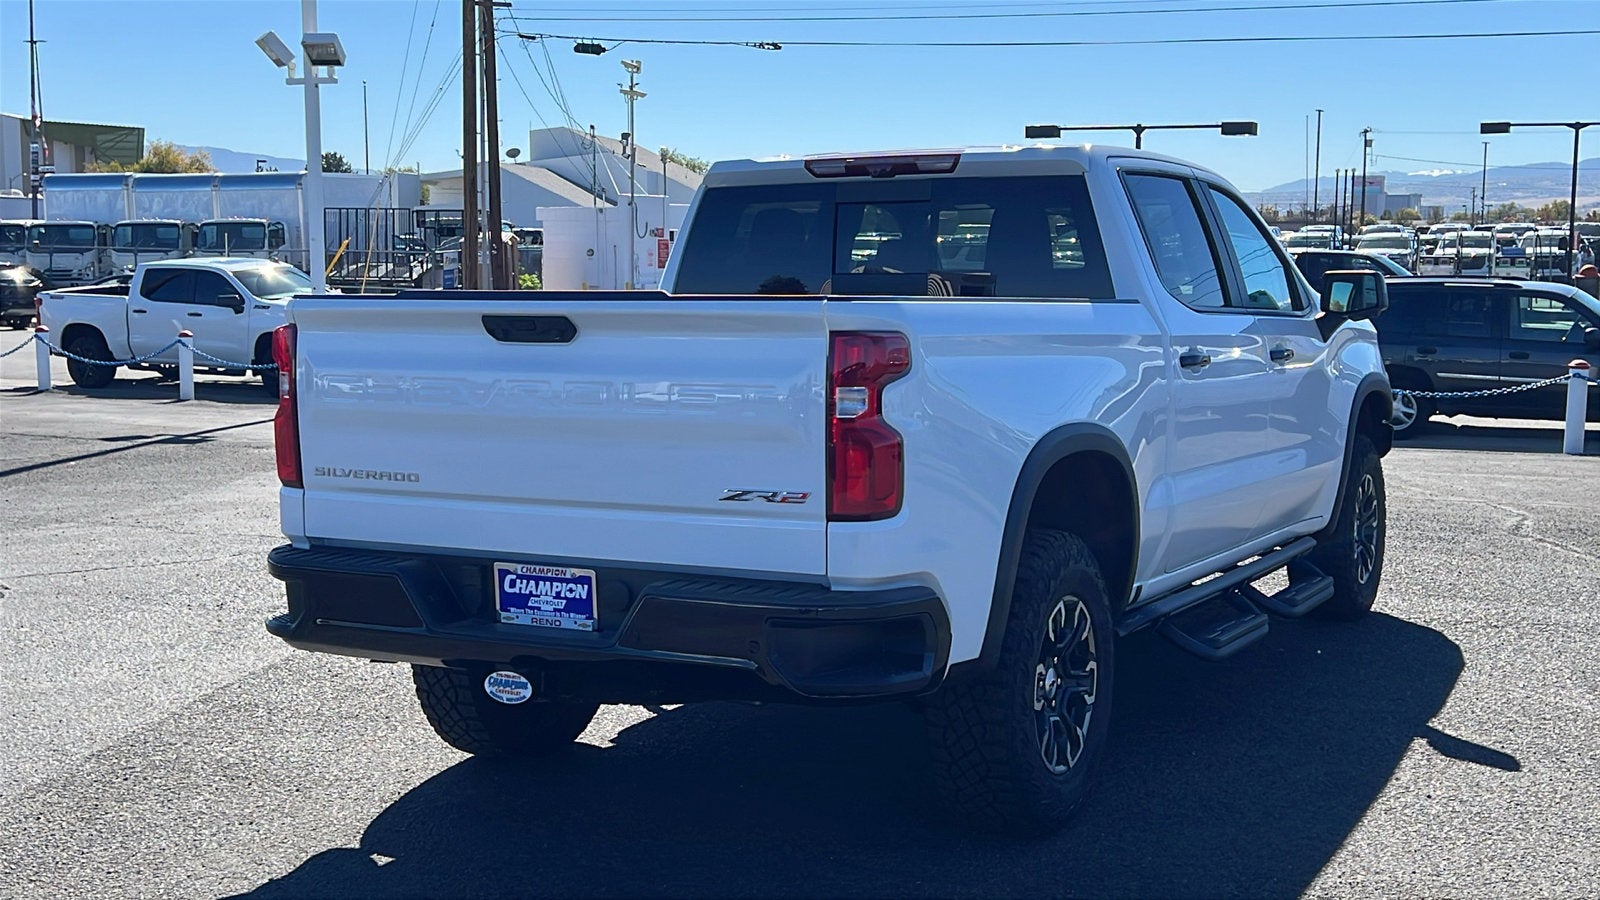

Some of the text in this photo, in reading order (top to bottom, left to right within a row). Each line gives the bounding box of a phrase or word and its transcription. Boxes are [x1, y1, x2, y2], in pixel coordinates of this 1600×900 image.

[314, 466, 420, 483] SILVERADO
[718, 488, 812, 504] ZR2
[520, 565, 567, 577] CHAMPION
[504, 574, 588, 599] CHAMPION
[530, 598, 564, 607] CHEVROLET
[531, 617, 562, 627] RENO
